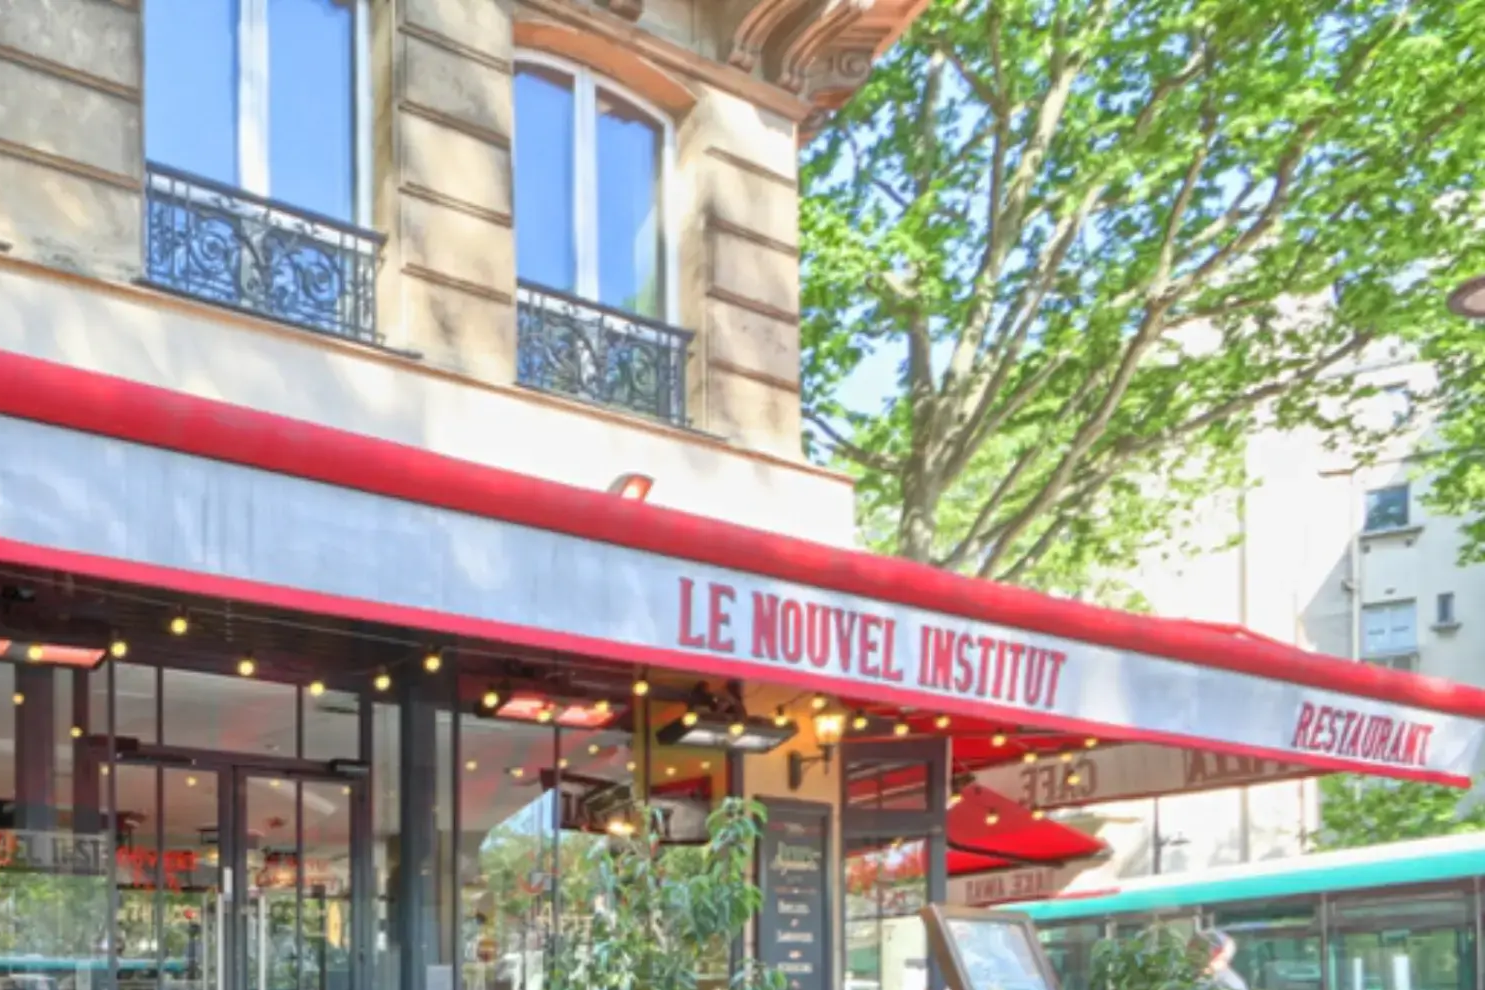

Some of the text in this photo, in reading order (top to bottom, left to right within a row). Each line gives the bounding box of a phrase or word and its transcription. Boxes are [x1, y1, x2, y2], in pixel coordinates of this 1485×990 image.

[677, 577, 1067, 708] LE NOUVEL INSTITUT
[1291, 699, 1434, 767] RESTAURANT
